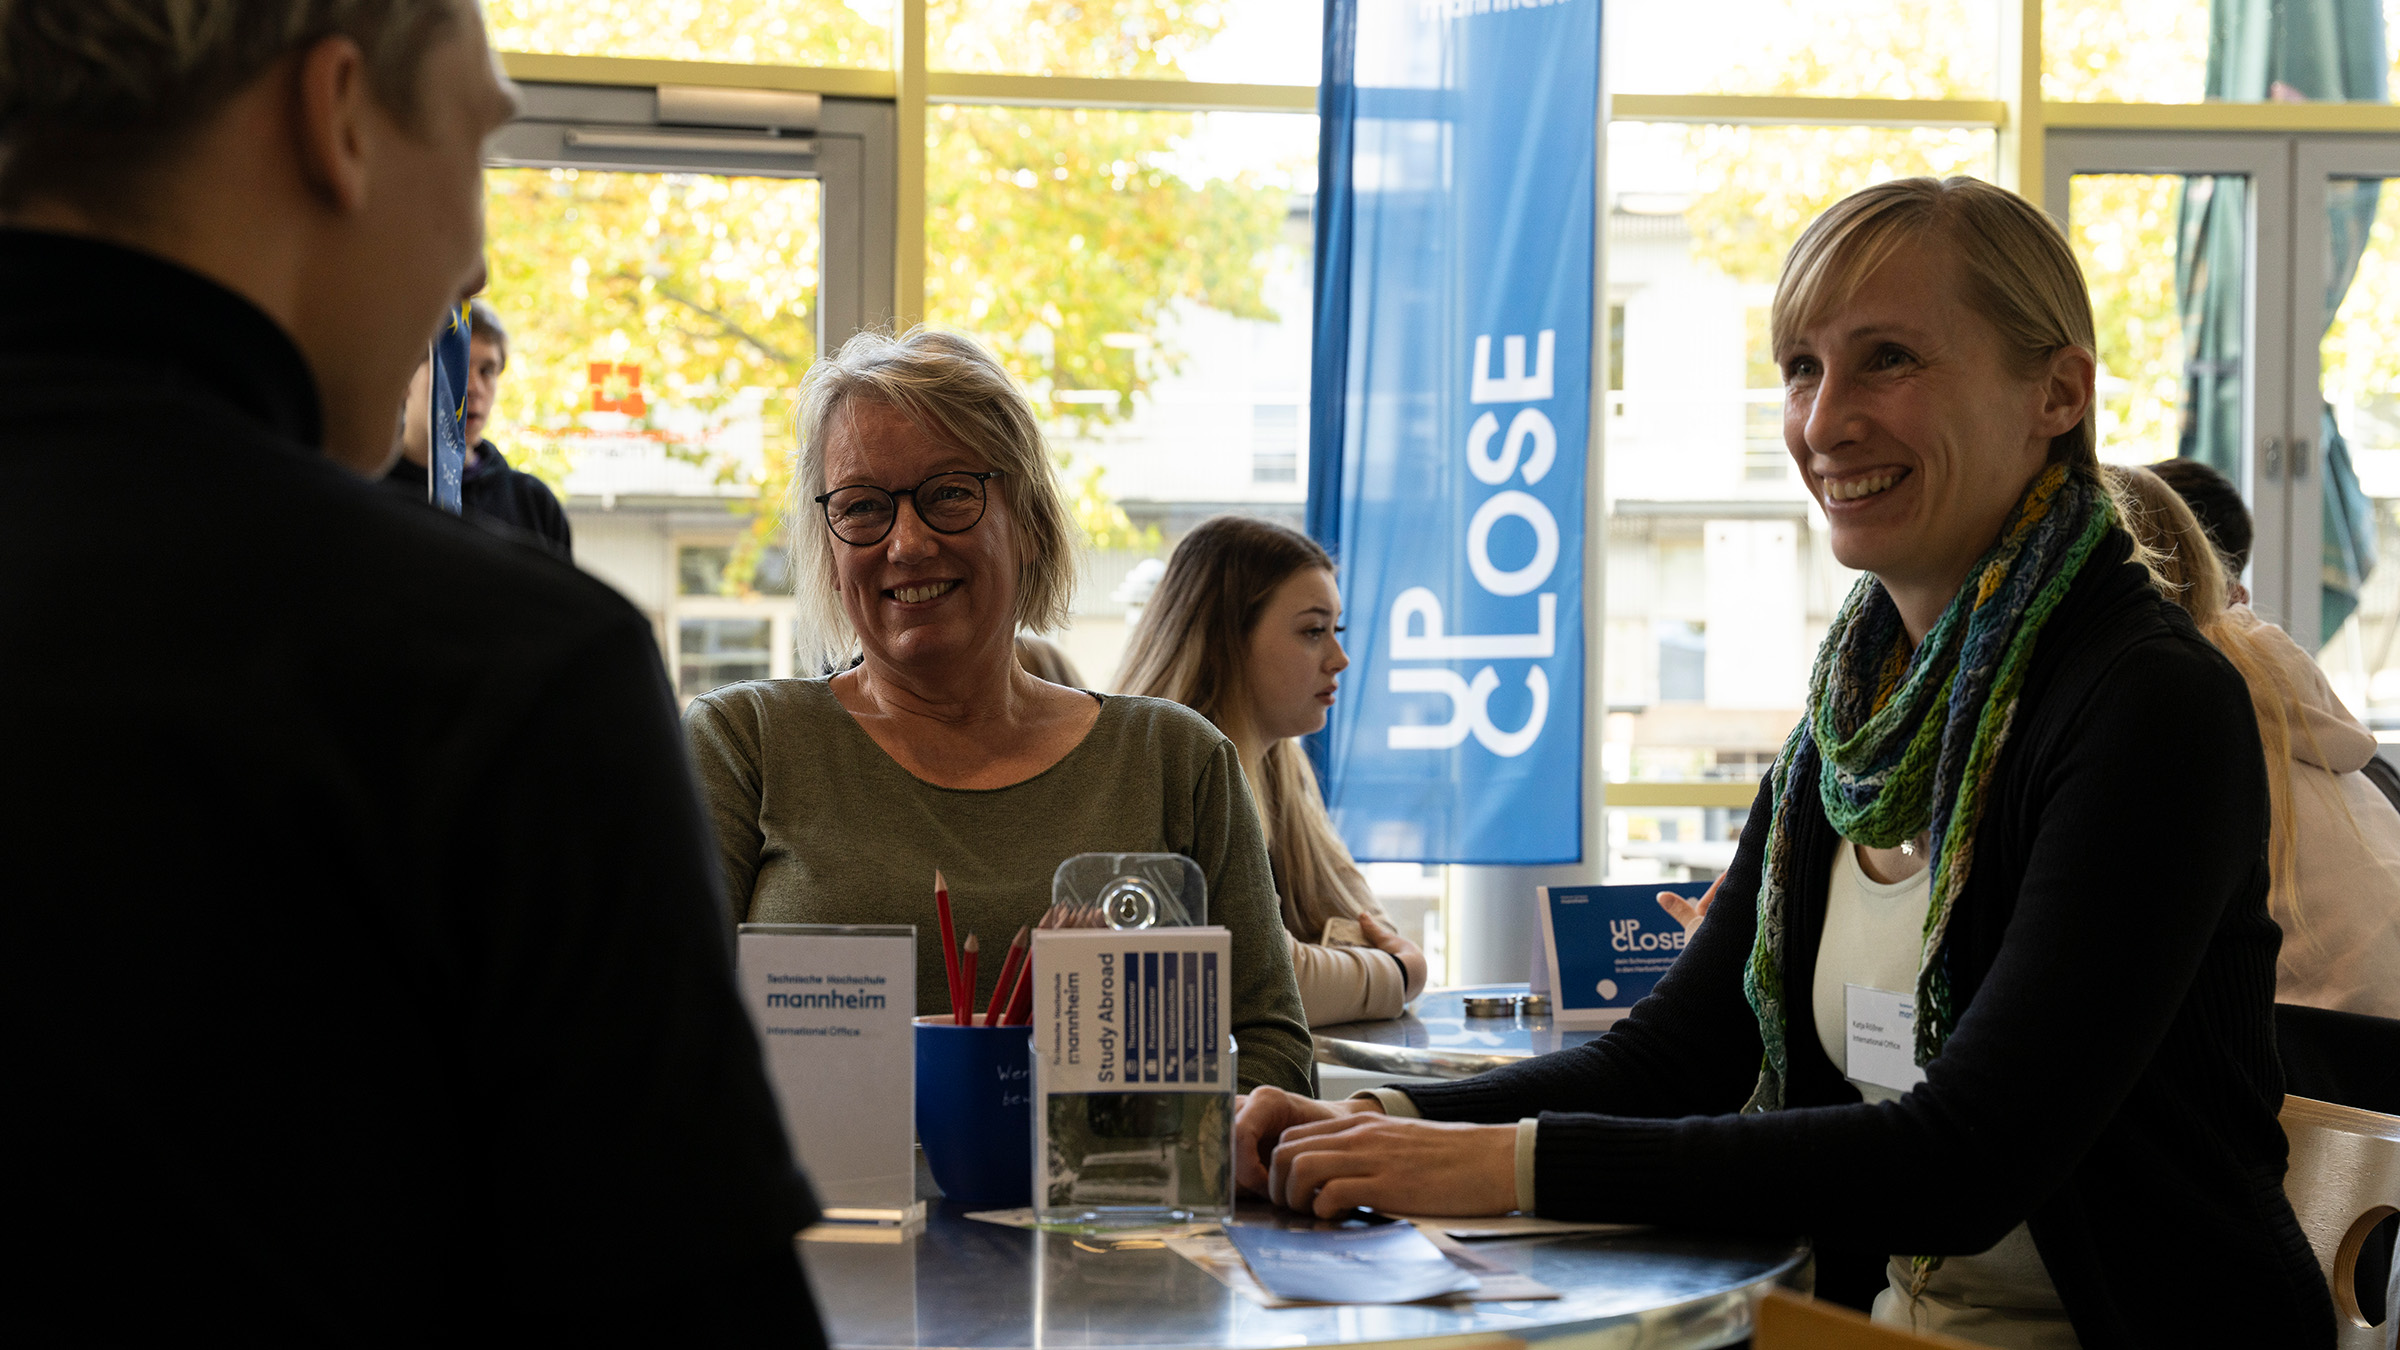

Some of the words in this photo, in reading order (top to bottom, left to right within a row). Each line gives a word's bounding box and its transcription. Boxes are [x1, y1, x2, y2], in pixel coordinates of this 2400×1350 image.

[1462, 328, 1560, 758] CLOSE
[1388, 586, 1473, 749] UP
[1610, 919, 1640, 936] UP
[1611, 932, 1686, 952] CLOSE
[767, 973, 823, 984] Technische
[826, 974, 887, 985] Hochschule
[767, 988, 886, 1009] mannheim
[1097, 953, 1115, 1023] Abroad
[766, 1026, 827, 1037] International
[829, 1026, 861, 1037] Office
[1064, 972, 1080, 1065] mannheim
[1097, 1026, 1118, 1083] Study
